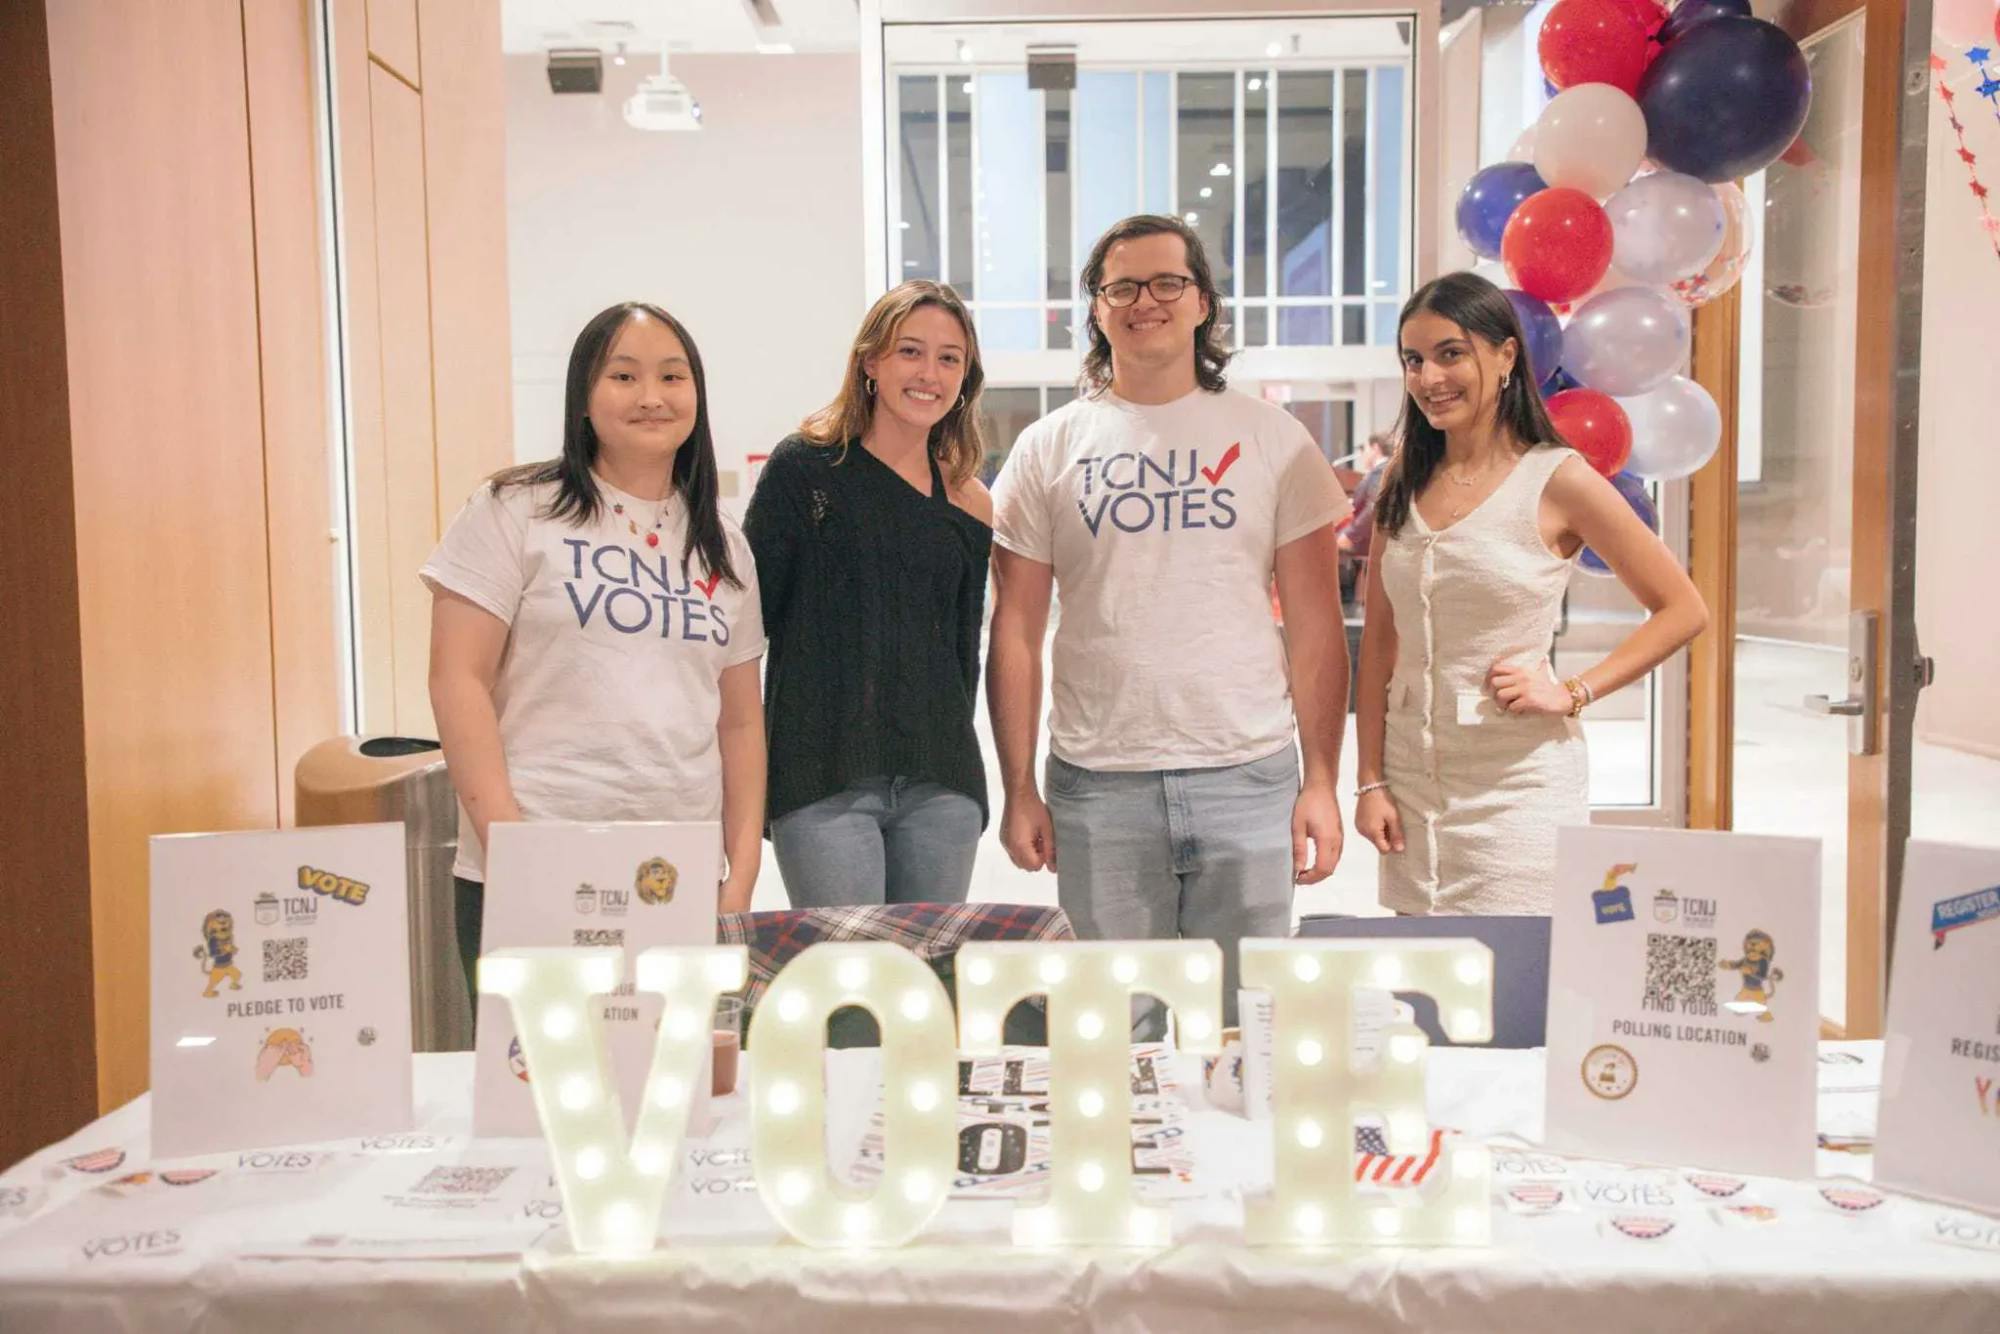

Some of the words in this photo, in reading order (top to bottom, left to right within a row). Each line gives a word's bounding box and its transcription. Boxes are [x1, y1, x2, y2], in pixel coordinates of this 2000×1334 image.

[1077, 449, 1197, 495] TCNJ
[1078, 487, 1237, 538] VOTES
[563, 538, 690, 596] TCNJ
[564, 581, 730, 647] VOTES
[299, 866, 369, 904] VOTE
[600, 889, 630, 906] TCNJ
[283, 897, 318, 915] TCNJ
[1682, 897, 1718, 917] TCNJ
[1937, 890, 1999, 919] REGISTER
[227, 998, 284, 1018] PLEDGE
[288, 997, 305, 1013] TO
[310, 993, 345, 1011] VOTE
[1642, 997, 1675, 1014] FIND
[1680, 999, 1719, 1017] YOUR
[1612, 1018, 1672, 1040] POLLING
[1676, 1026, 1748, 1046] LOCATION
[478, 938, 1493, 1256] VOTE
[237, 1152, 312, 1169] VOTES
[1584, 1180, 1675, 1207] VOTES
[81, 1228, 182, 1261] VOTES
